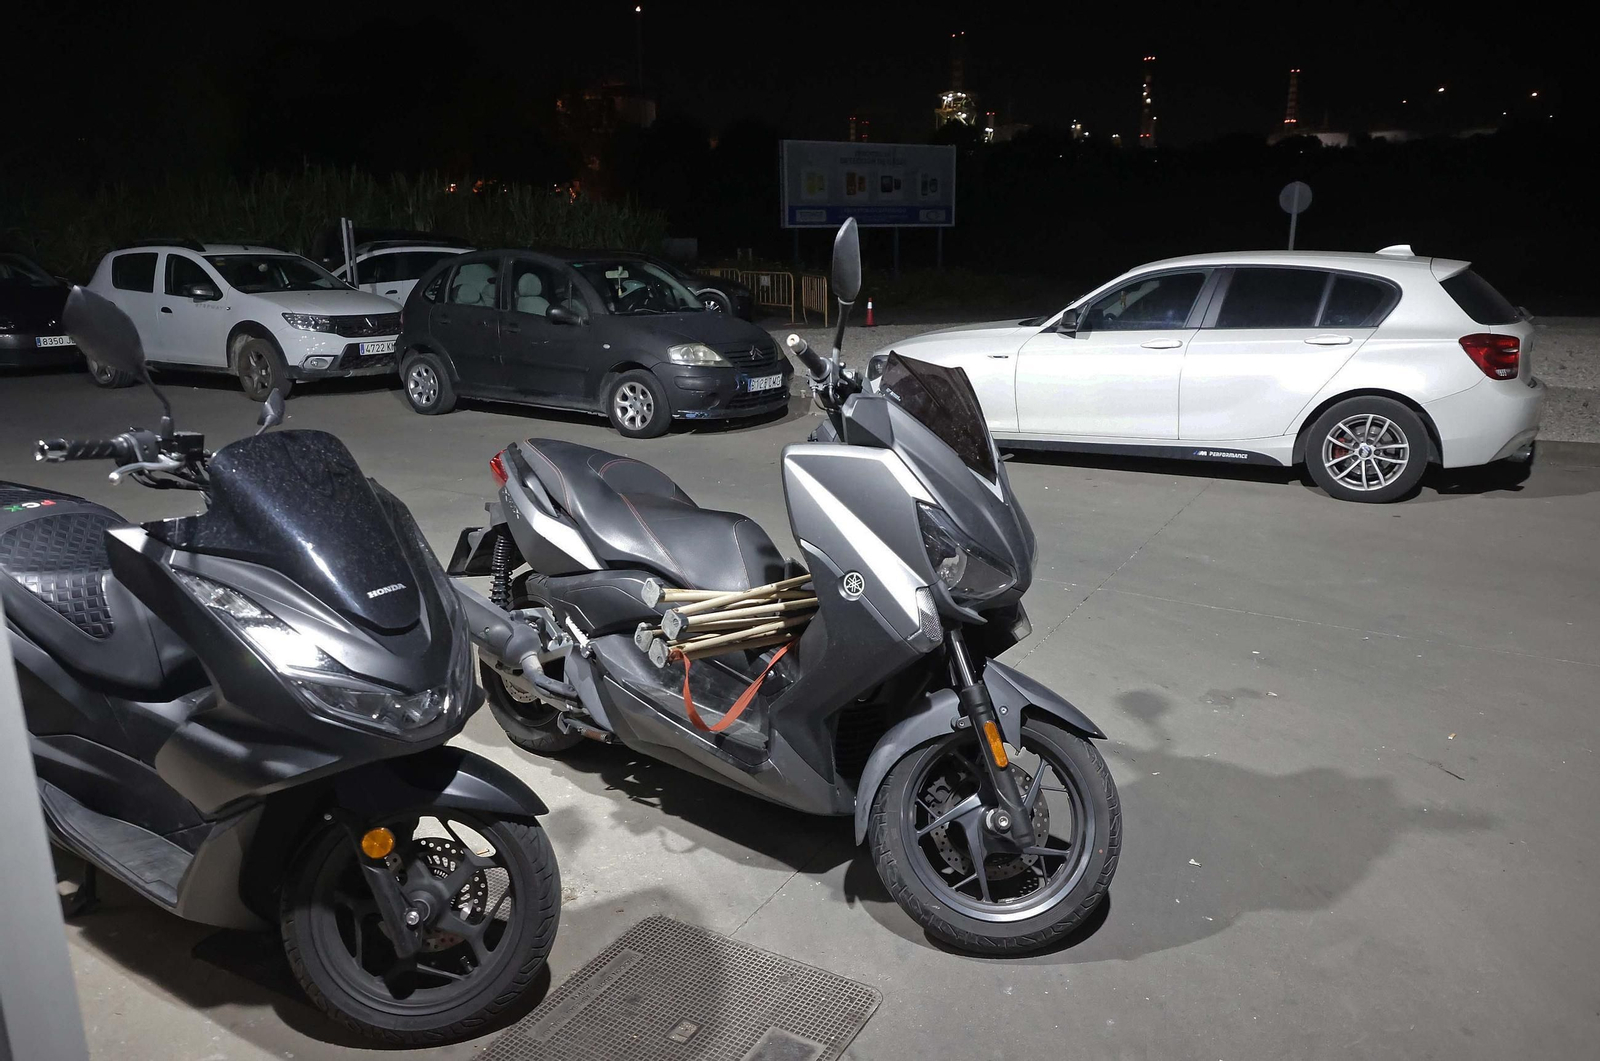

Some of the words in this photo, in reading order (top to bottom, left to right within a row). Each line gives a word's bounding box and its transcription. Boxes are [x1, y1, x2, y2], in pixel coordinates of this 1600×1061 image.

[42, 337, 64, 346] 8350
[365, 343, 385, 353] 4722
[1208, 450, 1249, 459] PERFORMANCE
[366, 582, 407, 599] HONDA
